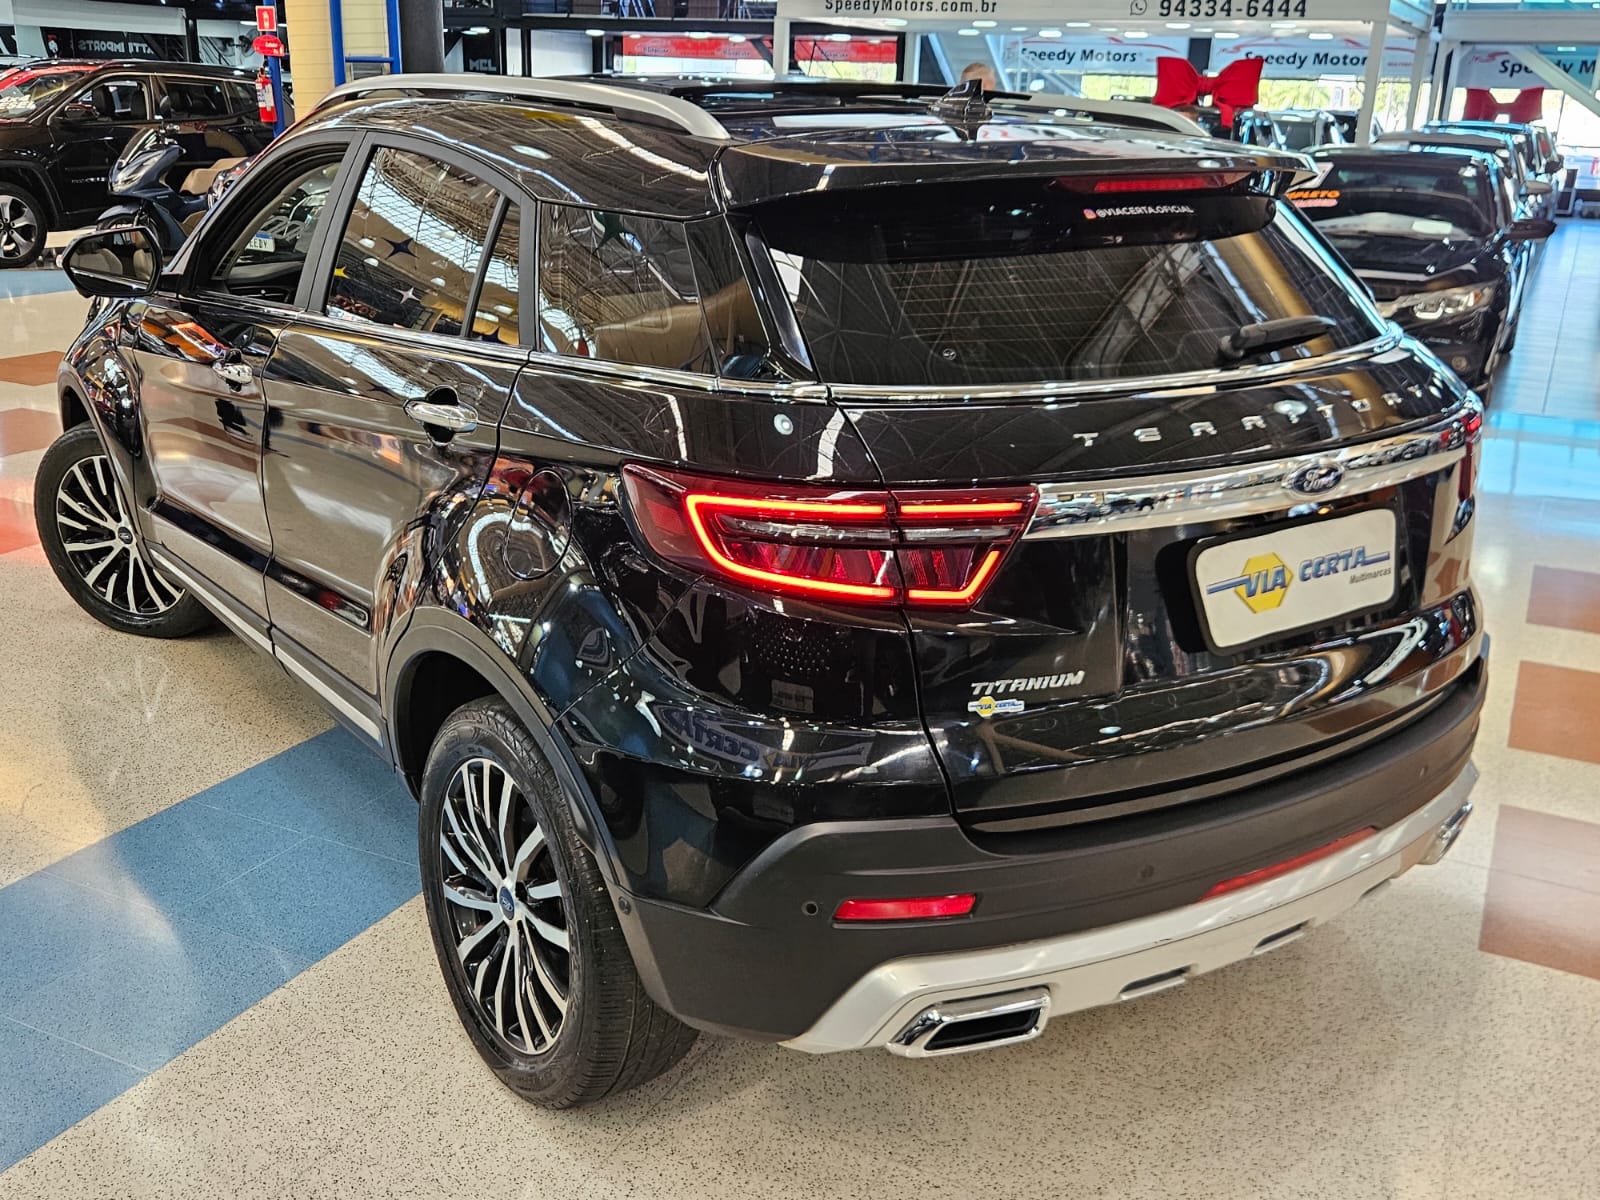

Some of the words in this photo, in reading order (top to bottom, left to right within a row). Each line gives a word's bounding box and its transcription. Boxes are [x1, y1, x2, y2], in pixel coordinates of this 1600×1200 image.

[825, 0, 997, 13] SpeedyMotors.com.br
[1158, 0, 1307, 17] 94334-6444
[1080, 49, 1137, 62] Motors
[1312, 52, 1368, 66] Motor
[1096, 205, 1195, 218] @VIACERTA.OFICIAL
[1073, 384, 1424, 447] TERRITORY
[1242, 565, 1288, 598] VIA
[1299, 546, 1368, 582] CERTA
[1349, 567, 1392, 584] Multimarcas
[971, 670, 1086, 695] TITANIUM
